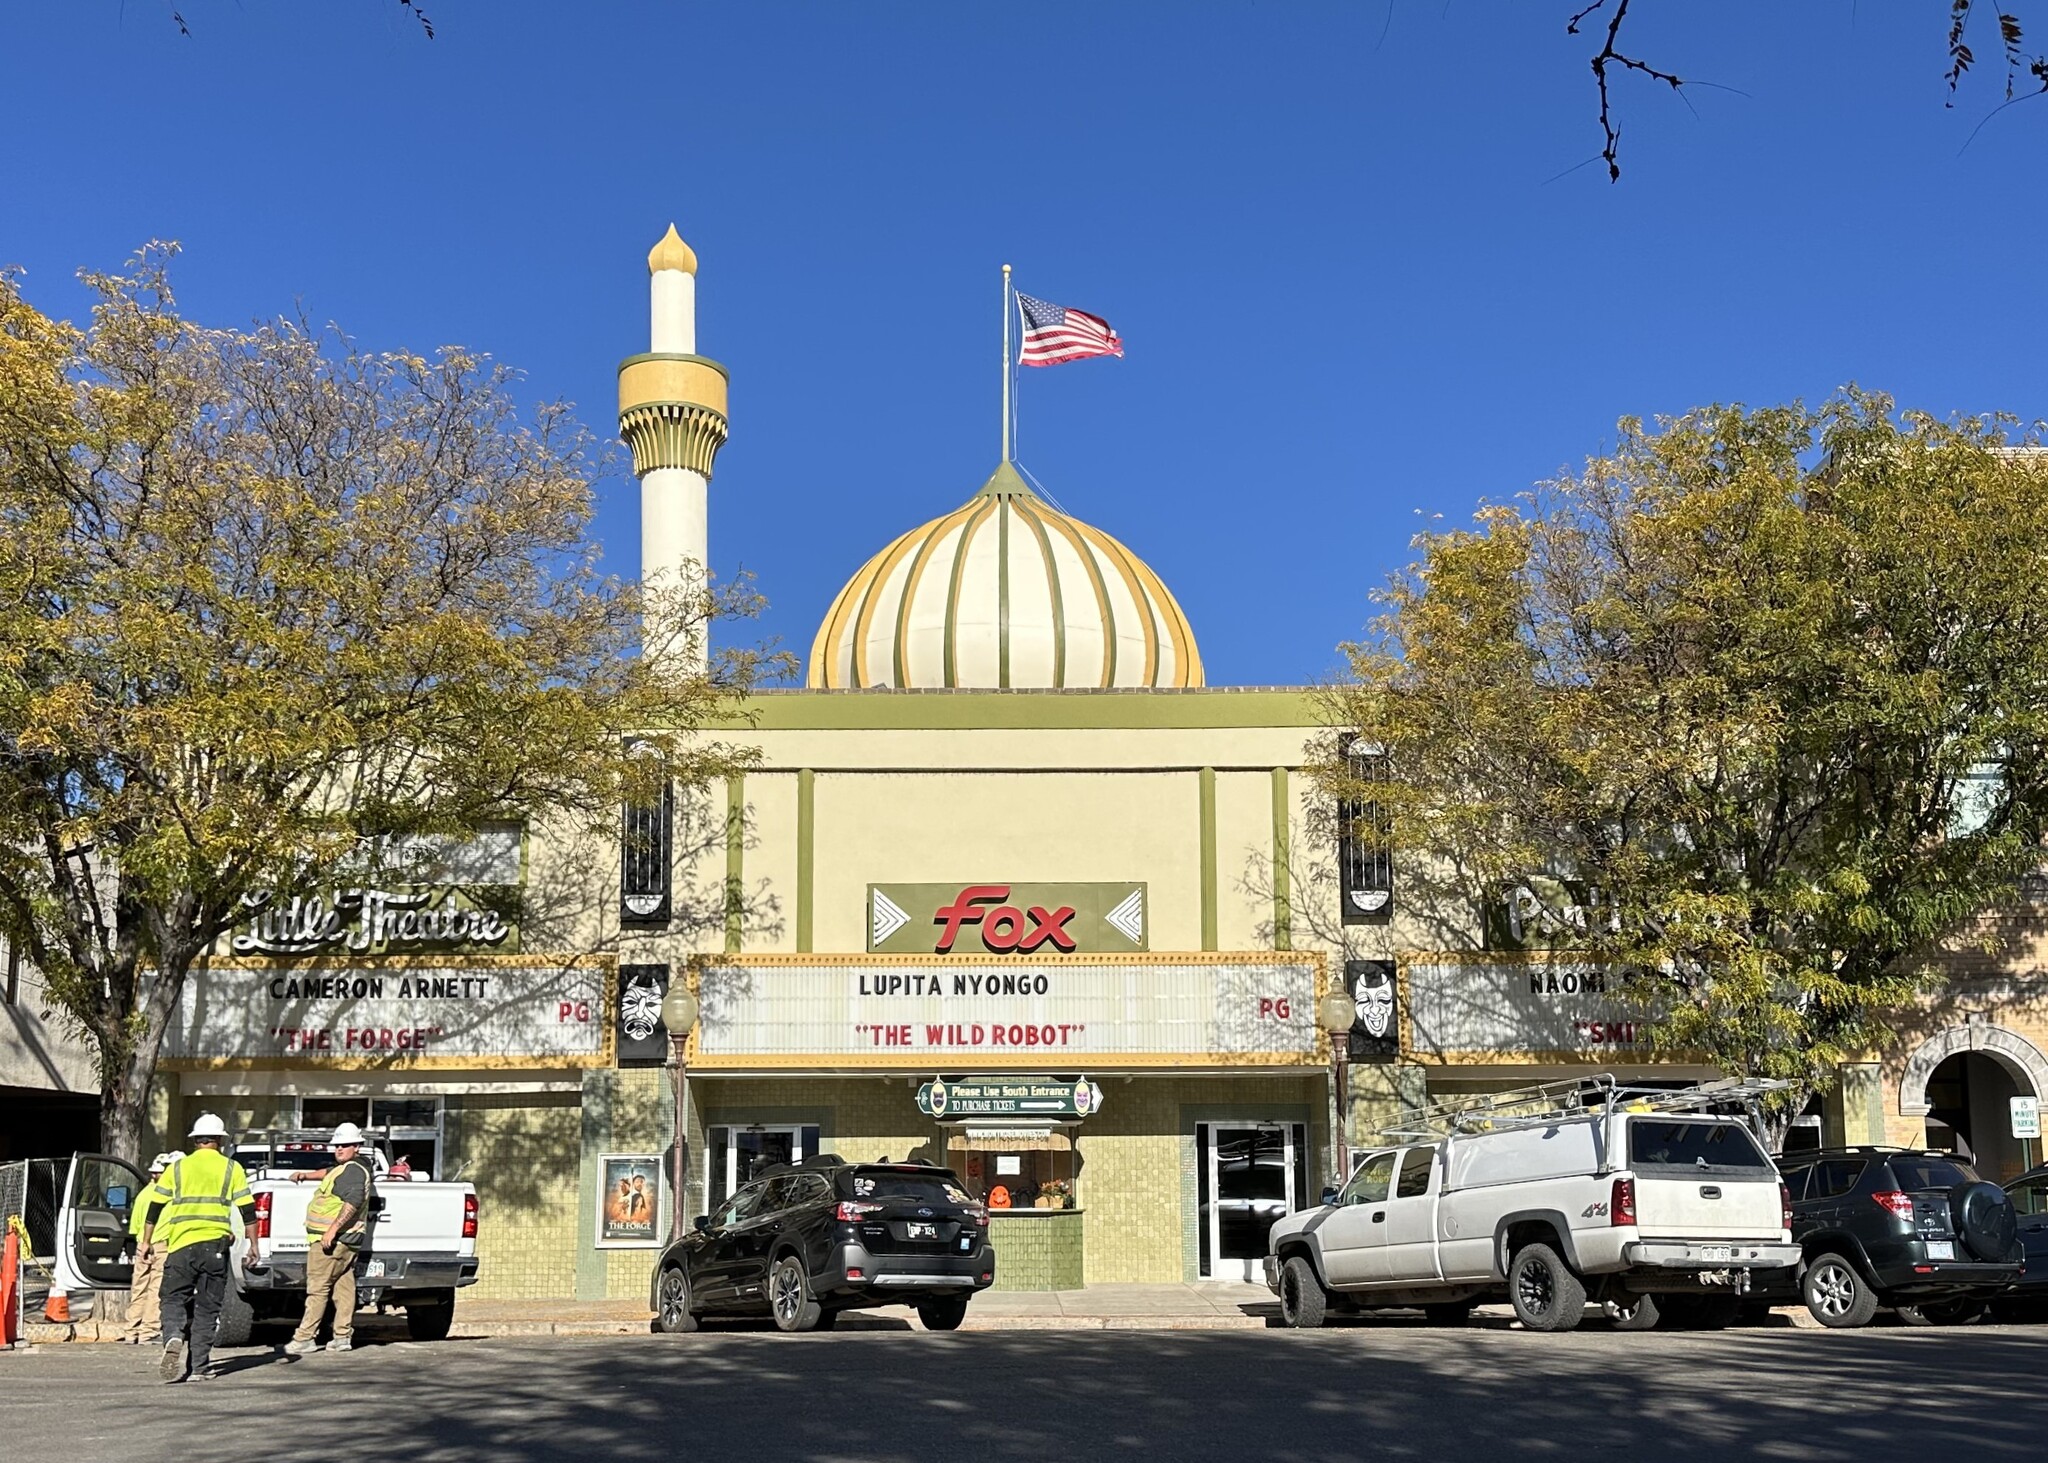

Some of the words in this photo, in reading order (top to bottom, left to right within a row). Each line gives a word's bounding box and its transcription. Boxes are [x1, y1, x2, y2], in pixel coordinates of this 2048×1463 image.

[233, 889, 349, 952] Little
[334, 888, 509, 951] Theatre
[269, 977, 383, 999] CAMERON
[399, 977, 489, 999] ARNETT
[859, 975, 942, 996] LUPITA
[953, 975, 1048, 996] NYONGO
[1530, 973, 1605, 994] NAOMI
[559, 1002, 588, 1022] PG
[1259, 998, 1290, 1019] PG
[270, 1027, 331, 1050] "THE
[345, 1026, 444, 1050] FORGE"
[855, 1025, 912, 1046] "THE
[926, 1025, 985, 1046] WILD
[992, 1025, 1086, 1046] ROBOT"
[952, 1086, 981, 1097] Please
[983, 1086, 1000, 1097] Use
[1002, 1086, 1029, 1097] South
[1030, 1086, 1070, 1097] Entrance
[952, 1100, 961, 1111] TO
[962, 1100, 992, 1111] PURCHASE
[993, 1100, 1016, 1111] TICKETS
[2014, 1110, 2036, 1119] MINUTE
[2020, 1100, 2029, 1109] 15
[2013, 1119, 2039, 1128] PARKING
[609, 1222, 625, 1230] THE
[626, 1222, 651, 1230] FORGE
